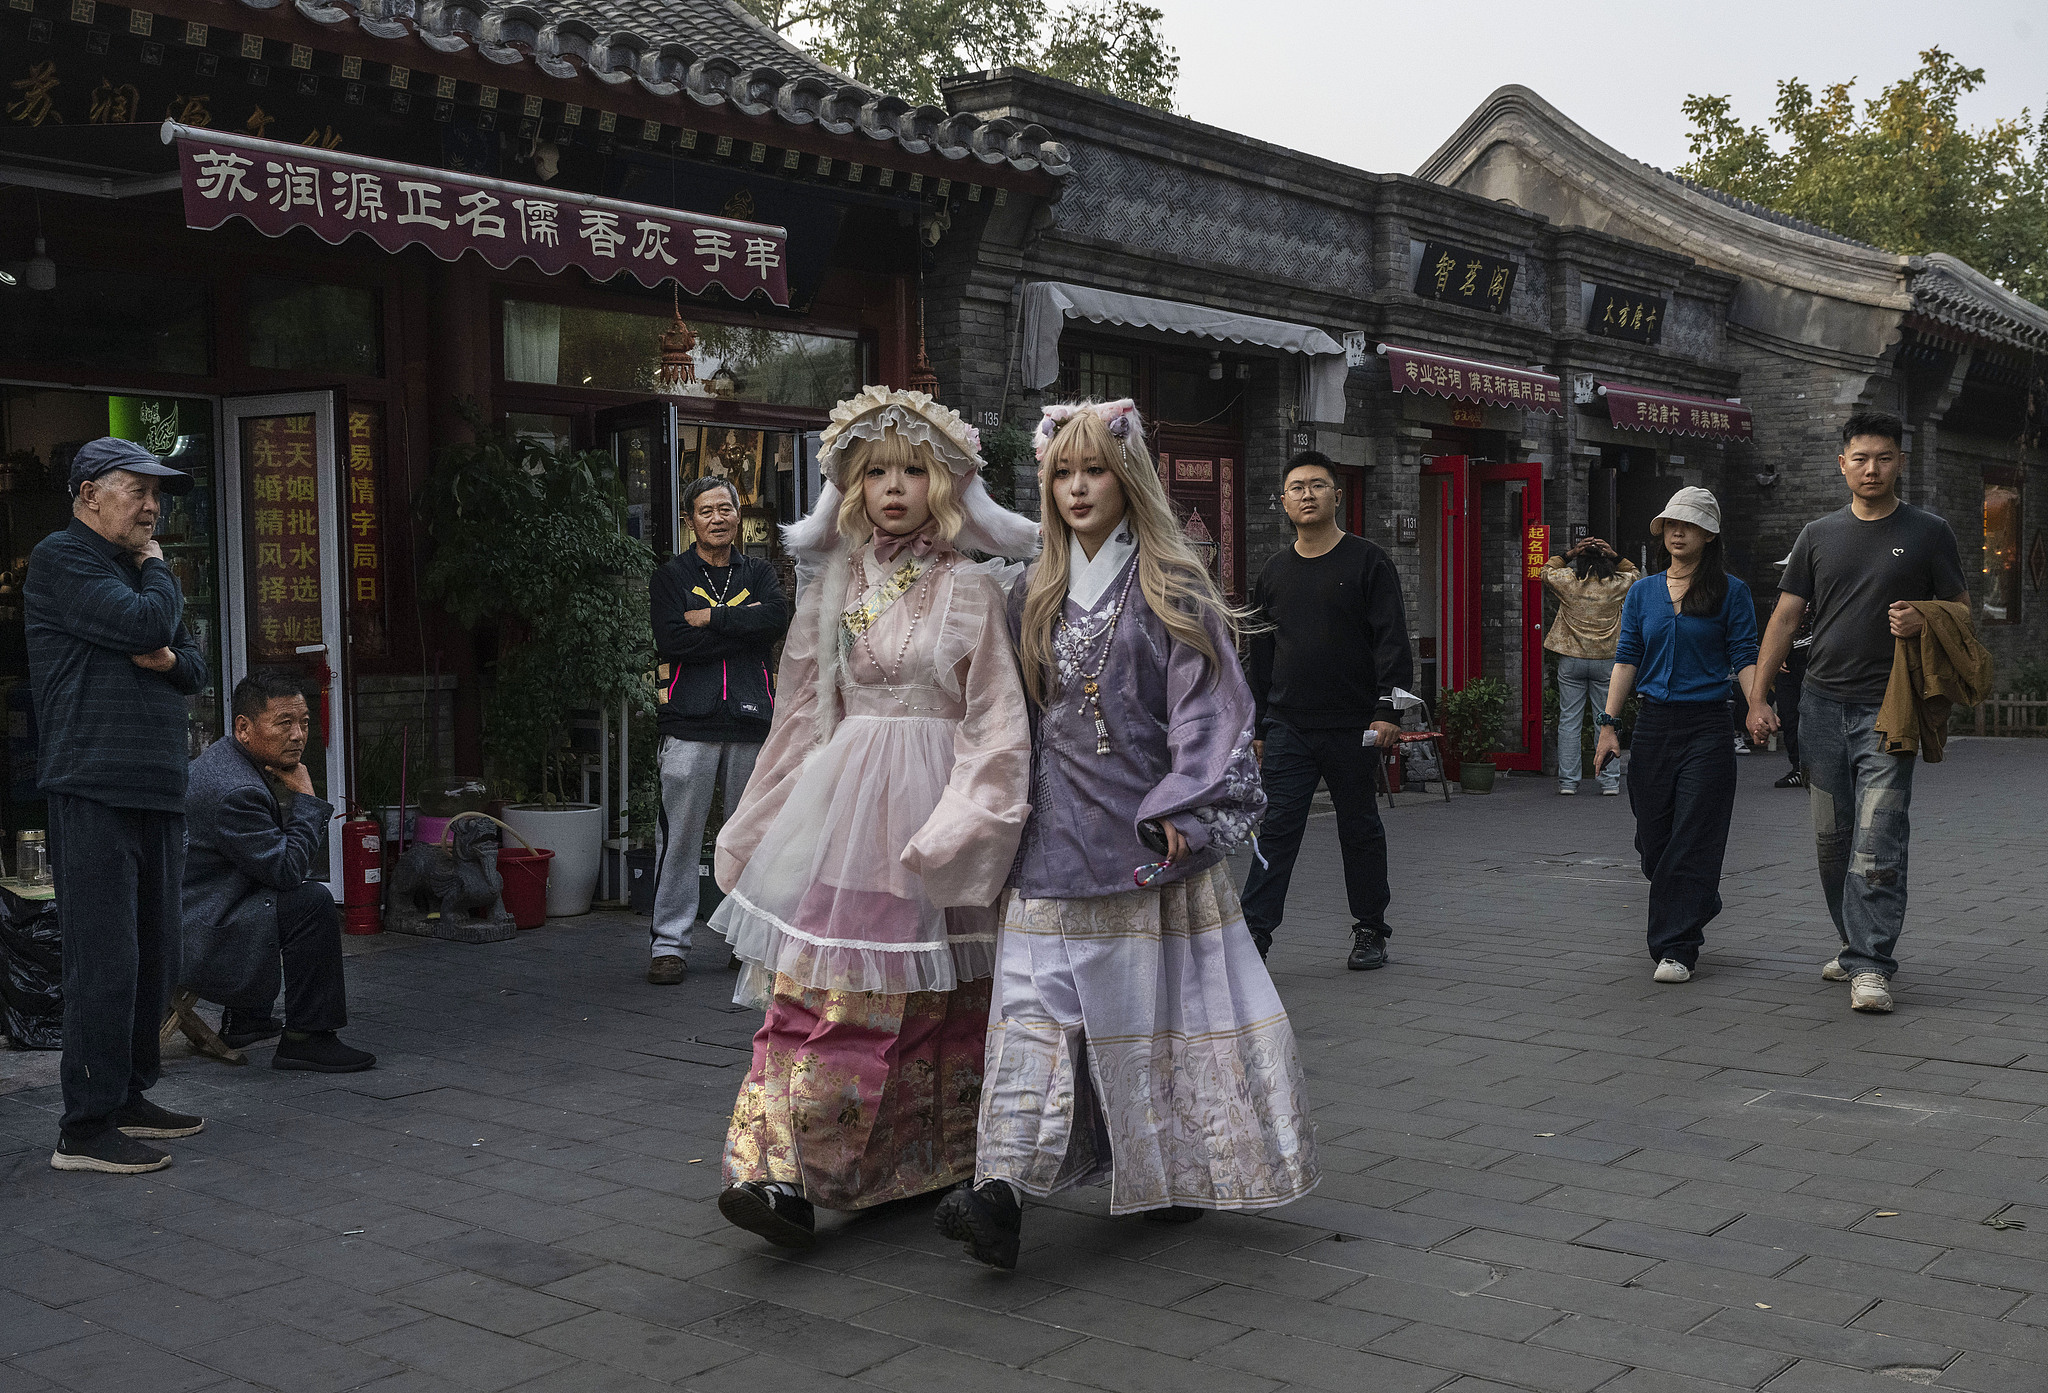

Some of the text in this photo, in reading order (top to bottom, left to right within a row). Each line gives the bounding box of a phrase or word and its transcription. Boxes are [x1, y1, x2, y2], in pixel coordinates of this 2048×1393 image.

[1434, 251, 1510, 305] 智茗阁
[1602, 296, 1657, 334] 大方唐卡
[1405, 360, 1546, 402] 专业咨询 佛系祈福用品
[983, 411, 999, 427] 135
[1637, 401, 1681, 425] 手绘唐卡
[1297, 433, 1309, 446] 133
[1406, 517, 1417, 529] 131
[1527, 526, 1545, 579] 起名预测
